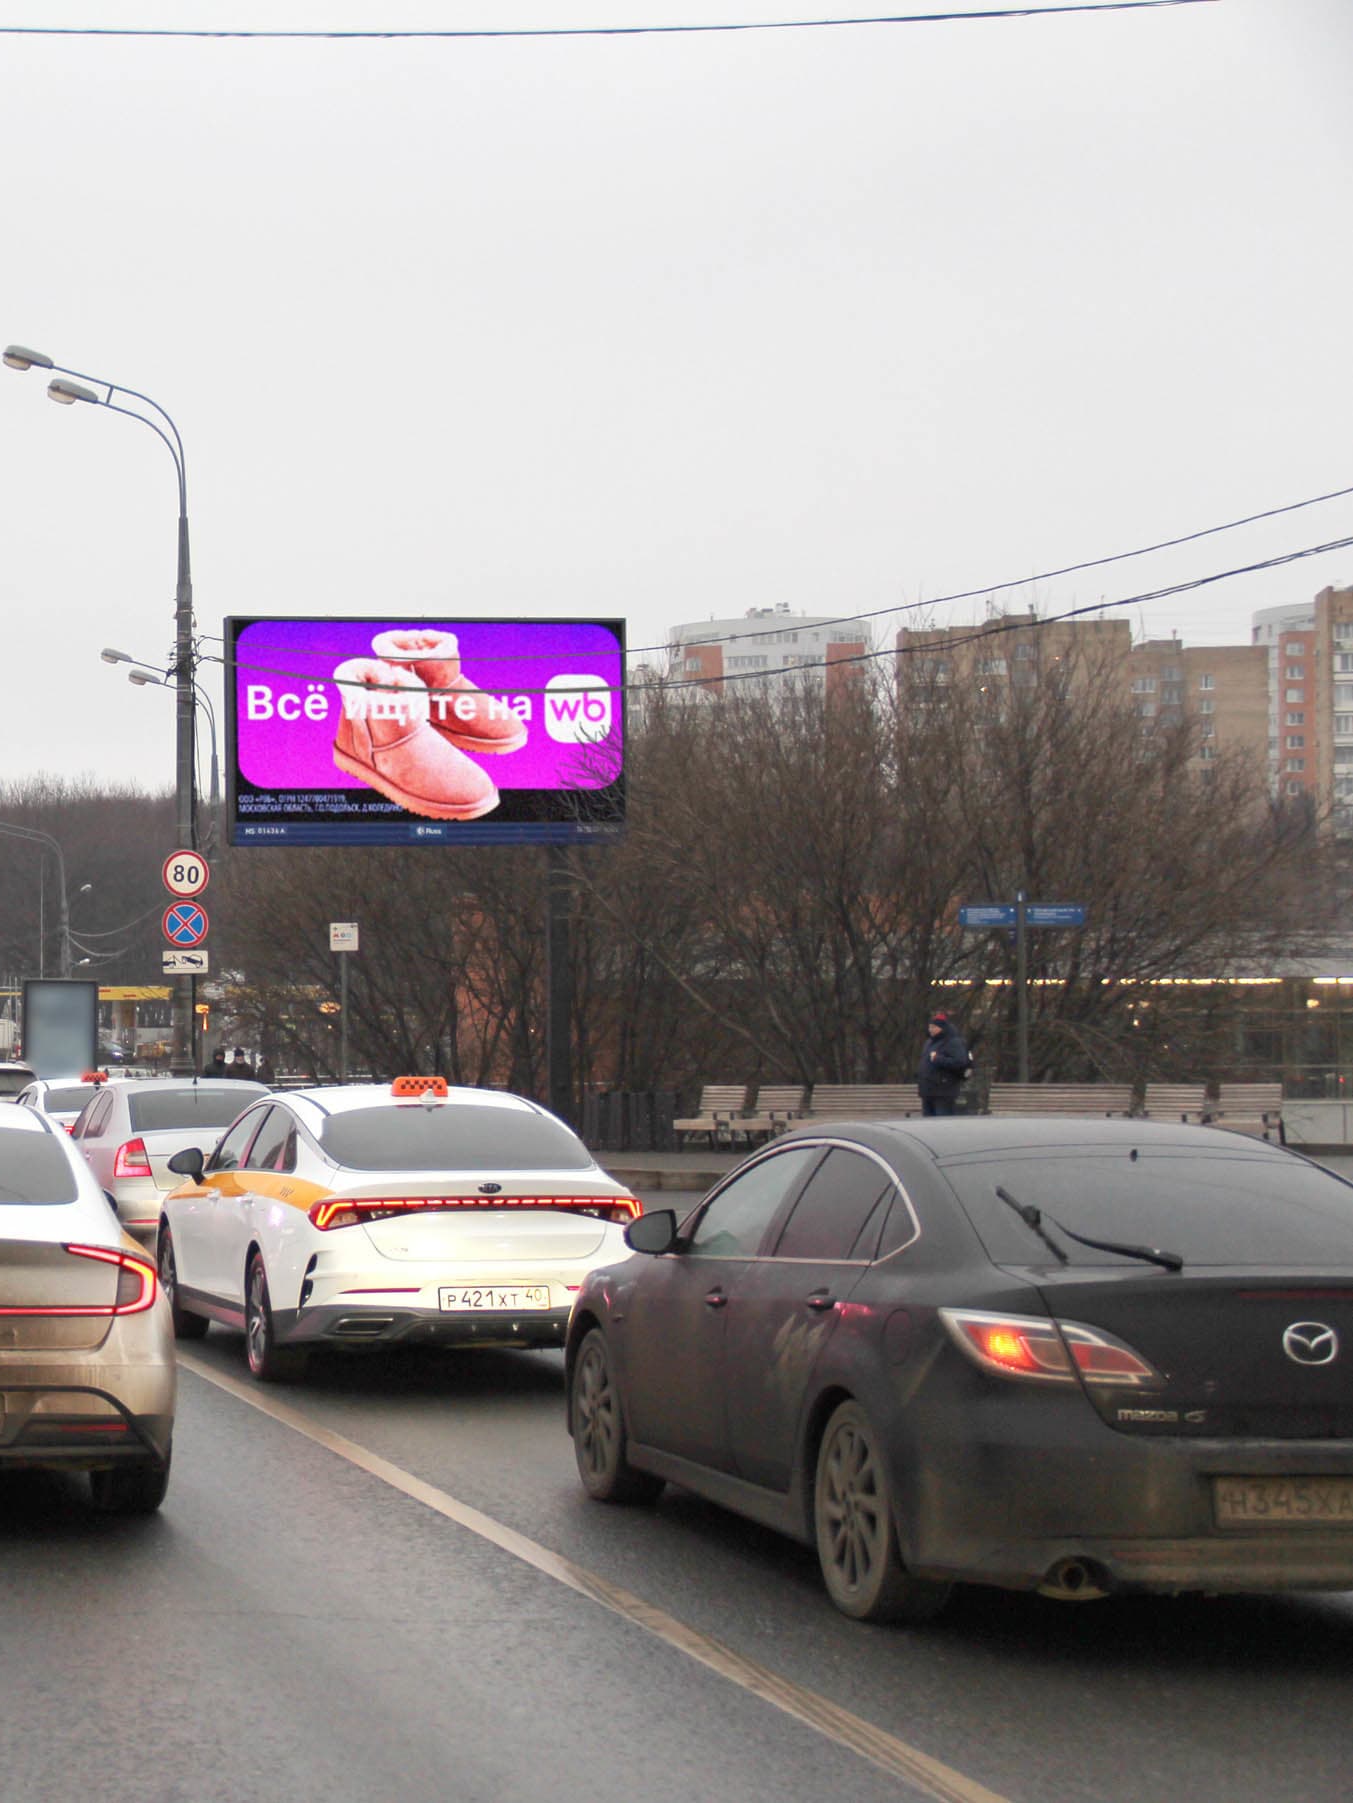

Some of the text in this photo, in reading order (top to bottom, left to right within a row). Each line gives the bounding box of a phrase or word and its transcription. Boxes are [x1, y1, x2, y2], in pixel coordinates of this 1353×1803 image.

[247, 684, 328, 720] Всё
[488, 695, 533, 720] на
[550, 689, 606, 722] wb
[173, 865, 199, 884] 80
[1117, 1409, 1179, 1422] mazda
